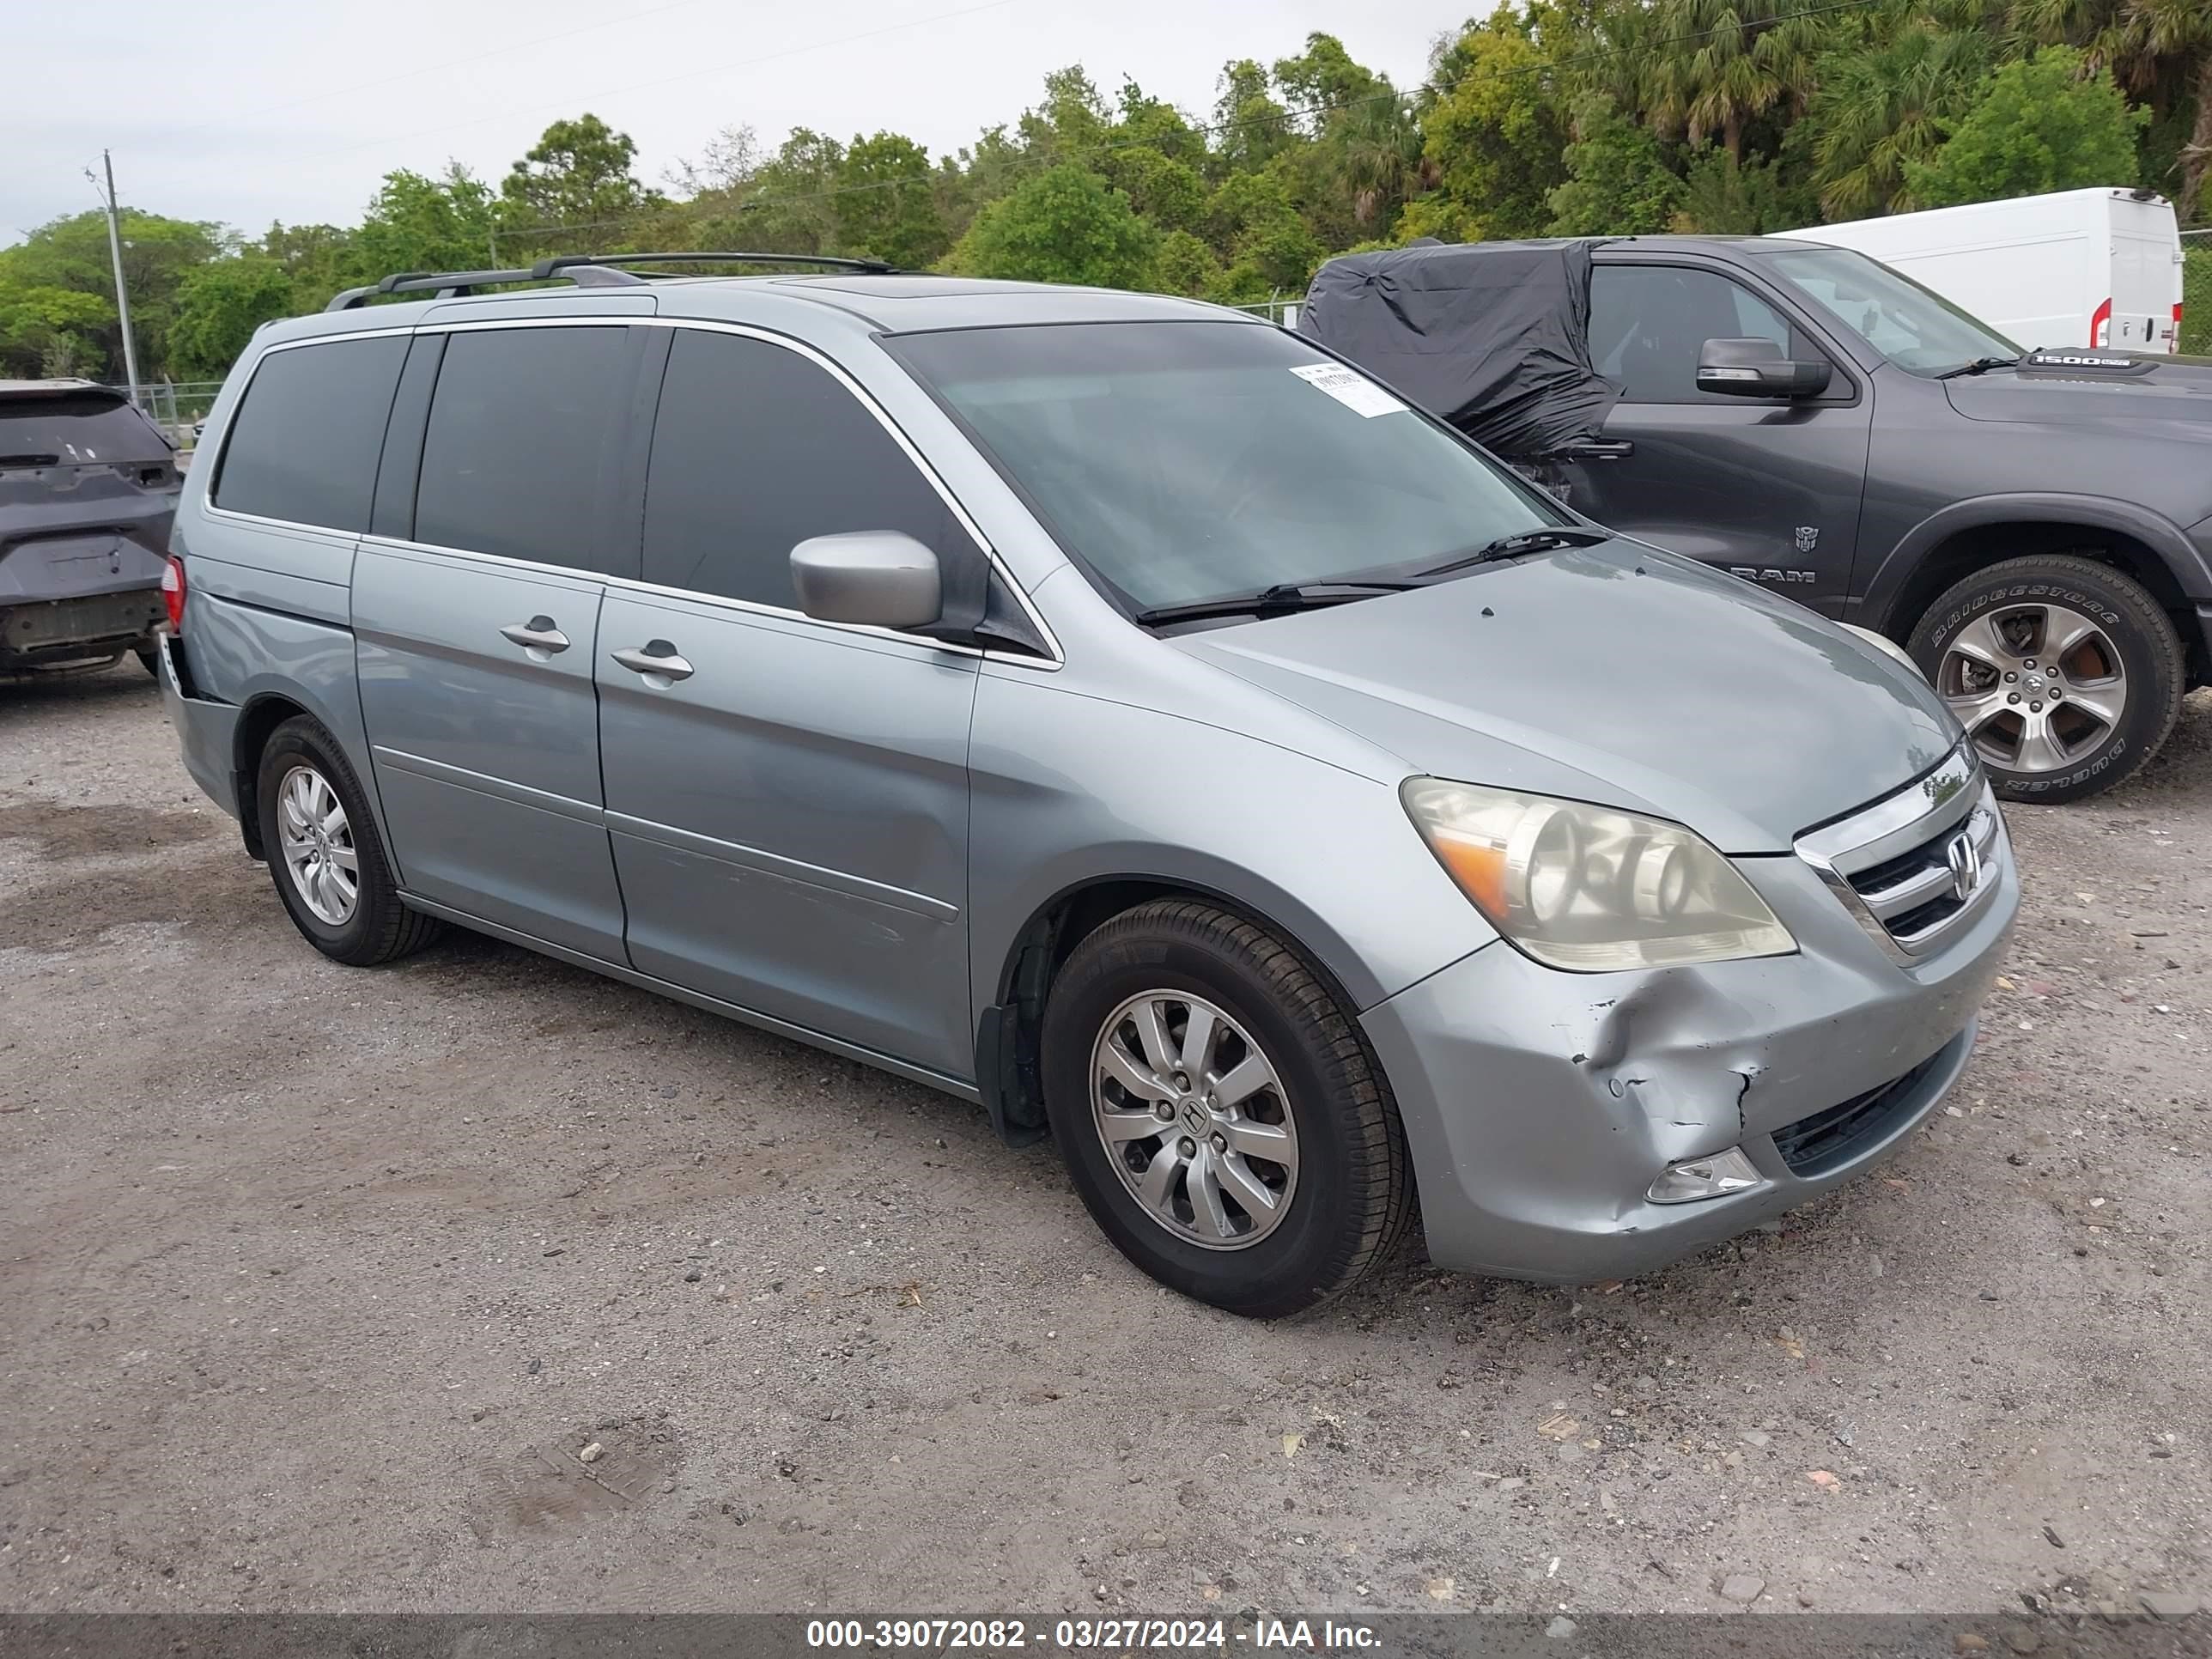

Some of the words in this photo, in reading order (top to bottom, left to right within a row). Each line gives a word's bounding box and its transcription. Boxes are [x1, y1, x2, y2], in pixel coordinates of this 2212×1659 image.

[2035, 355, 2101, 366] 1500
[1730, 567, 1816, 584] RAM
[1932, 584, 2121, 648] BRIDGESTONE
[2005, 737, 2126, 793] DUELER
